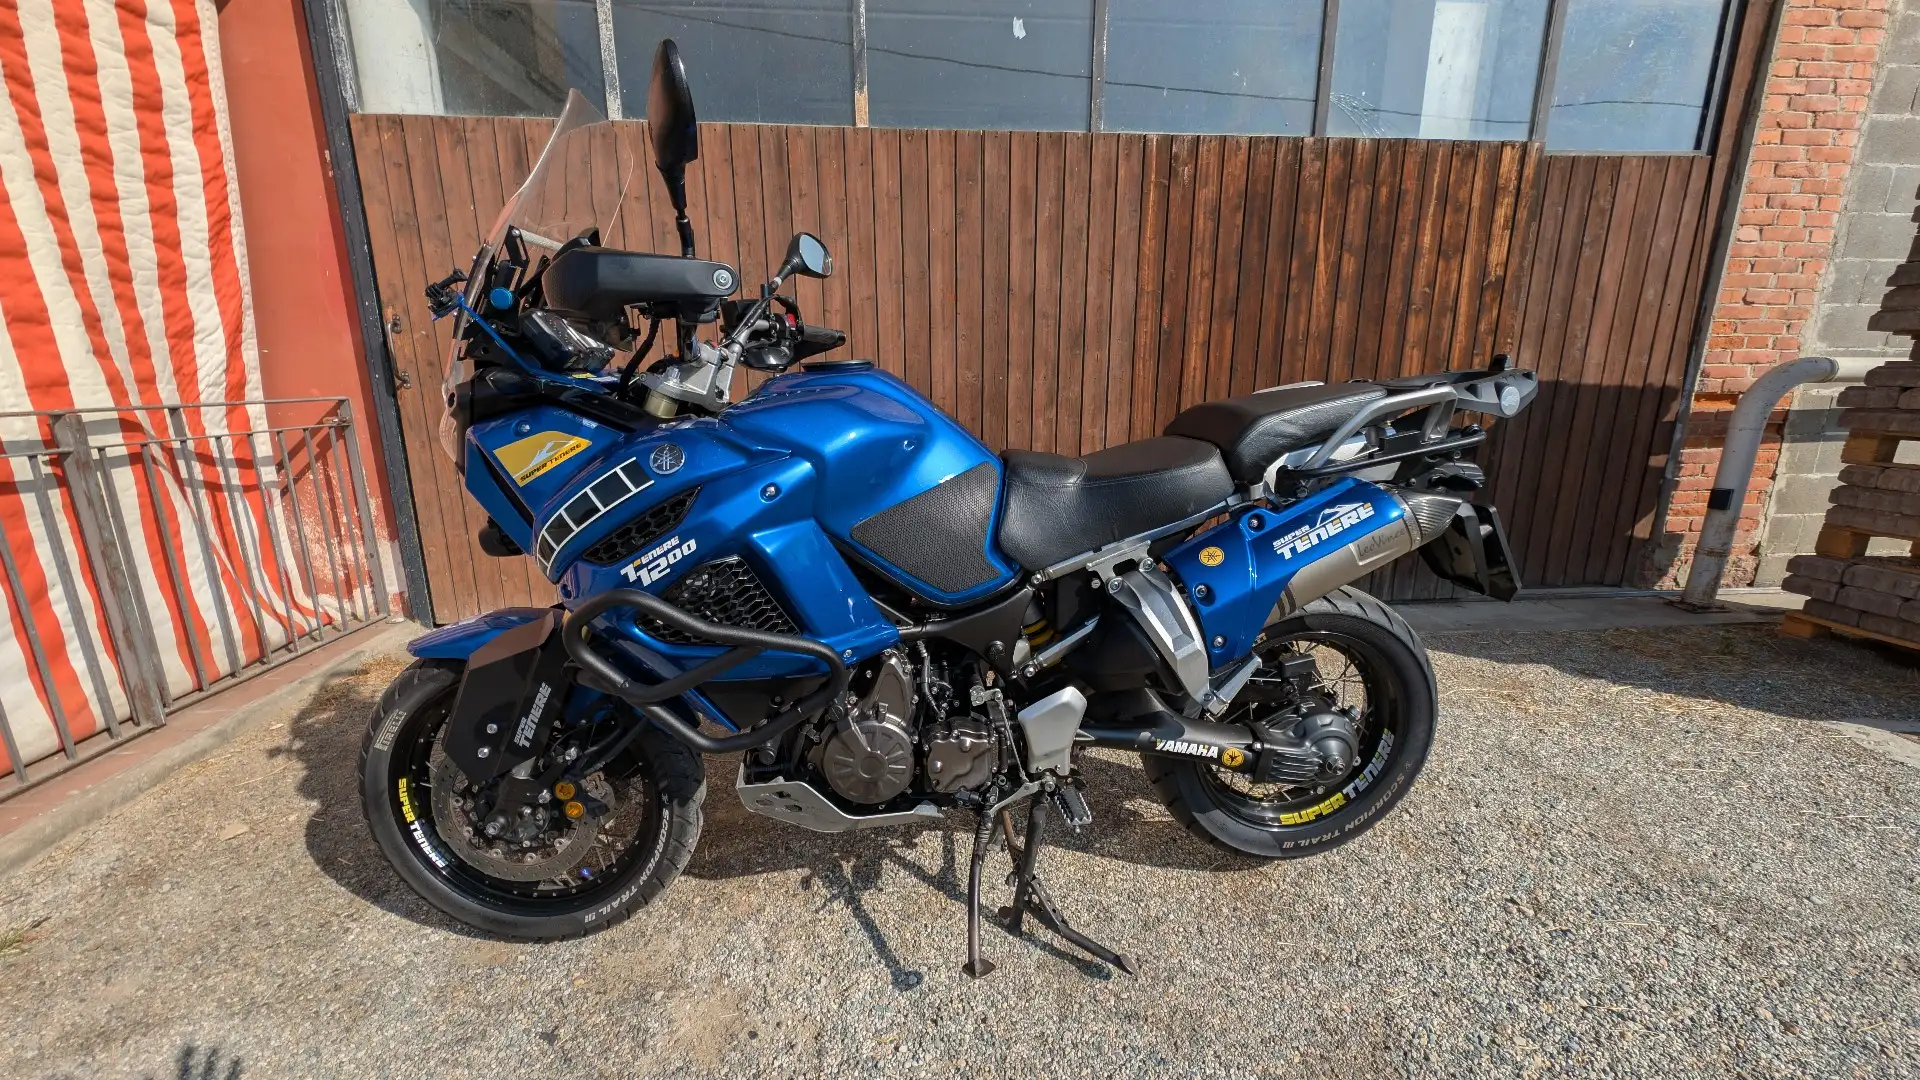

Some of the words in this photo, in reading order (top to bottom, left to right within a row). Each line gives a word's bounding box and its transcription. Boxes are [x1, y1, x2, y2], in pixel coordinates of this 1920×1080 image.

[520, 462, 548, 482] SUPER
[1273, 525, 1311, 548] SUPER
[1276, 502, 1375, 560] TENERE
[637, 538, 697, 587] 1200
[373, 709, 407, 751] PIRELLI
[513, 716, 527, 745] SUPER
[519, 682, 552, 748] TENERE
[1155, 738, 1219, 759] YAMAHA
[1280, 792, 1347, 825] SUPER
[1343, 727, 1395, 800] TENERE
[398, 778, 416, 824] SUPER
[410, 820, 448, 868] TENERE
[1344, 773, 1405, 832] SCORPION
[639, 808, 669, 886] SCORPION
[1298, 829, 1340, 847] TRAIL
[599, 885, 638, 915] TRAIL
